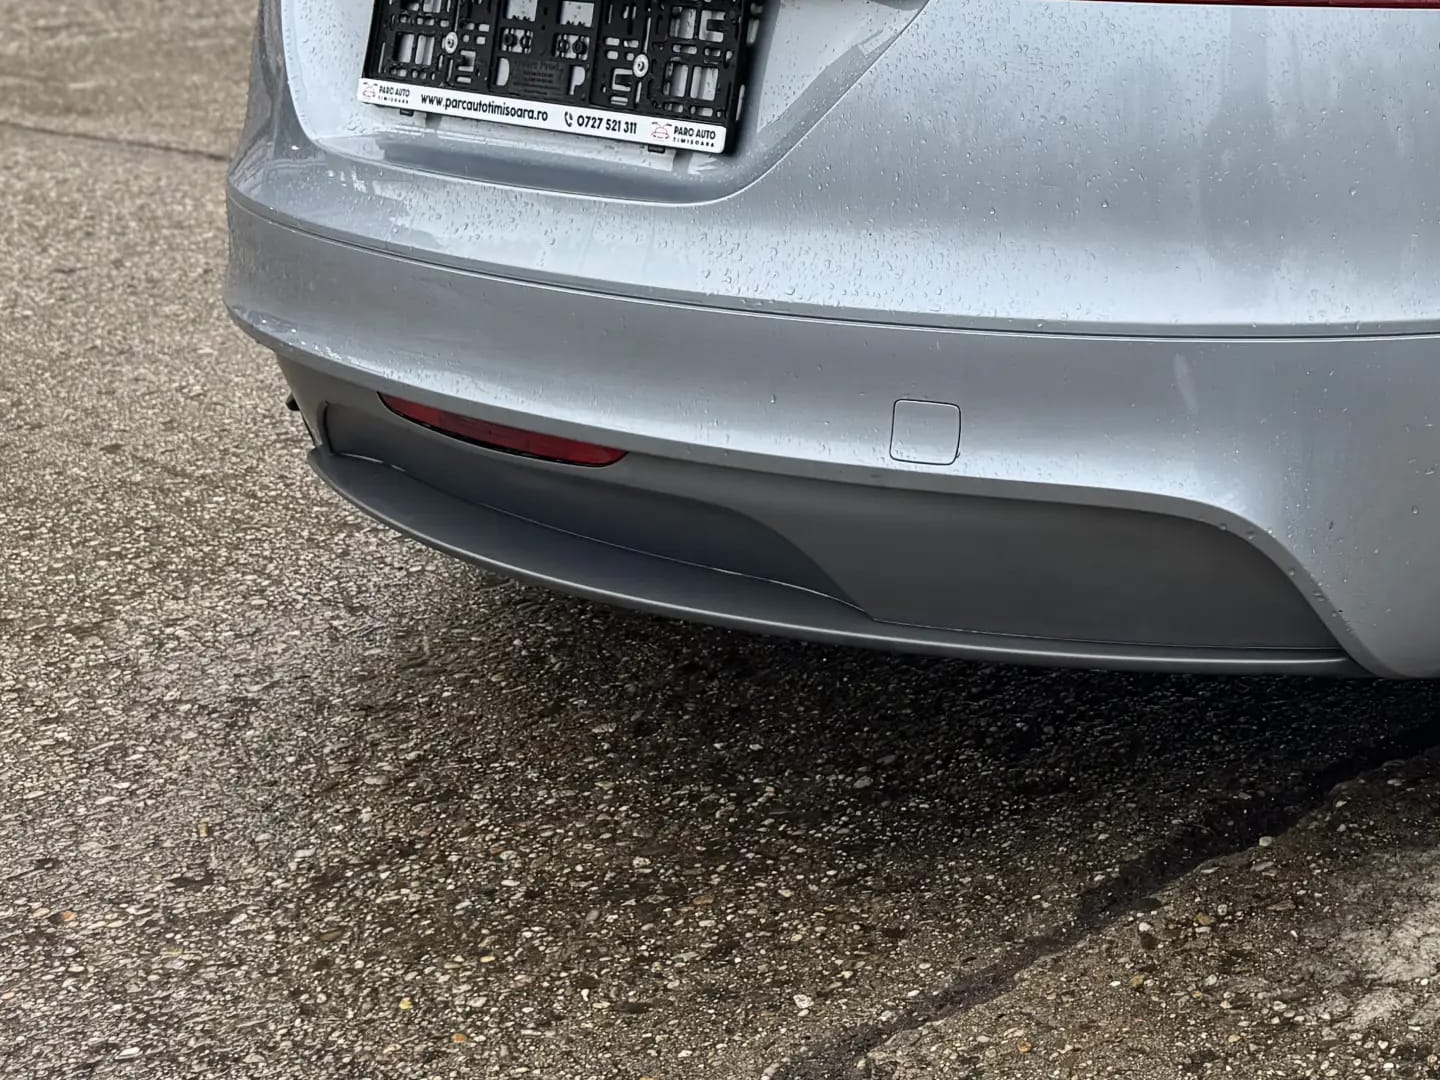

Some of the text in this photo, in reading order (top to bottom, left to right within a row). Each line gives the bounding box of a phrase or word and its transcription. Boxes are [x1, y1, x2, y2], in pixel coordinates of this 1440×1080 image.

[395, 87, 411, 98] AUTO
[420, 93, 549, 122] www.parcautotimisoara.ro
[577, 115, 637, 135] 0727 521 311
[695, 128, 716, 140] AUTO
